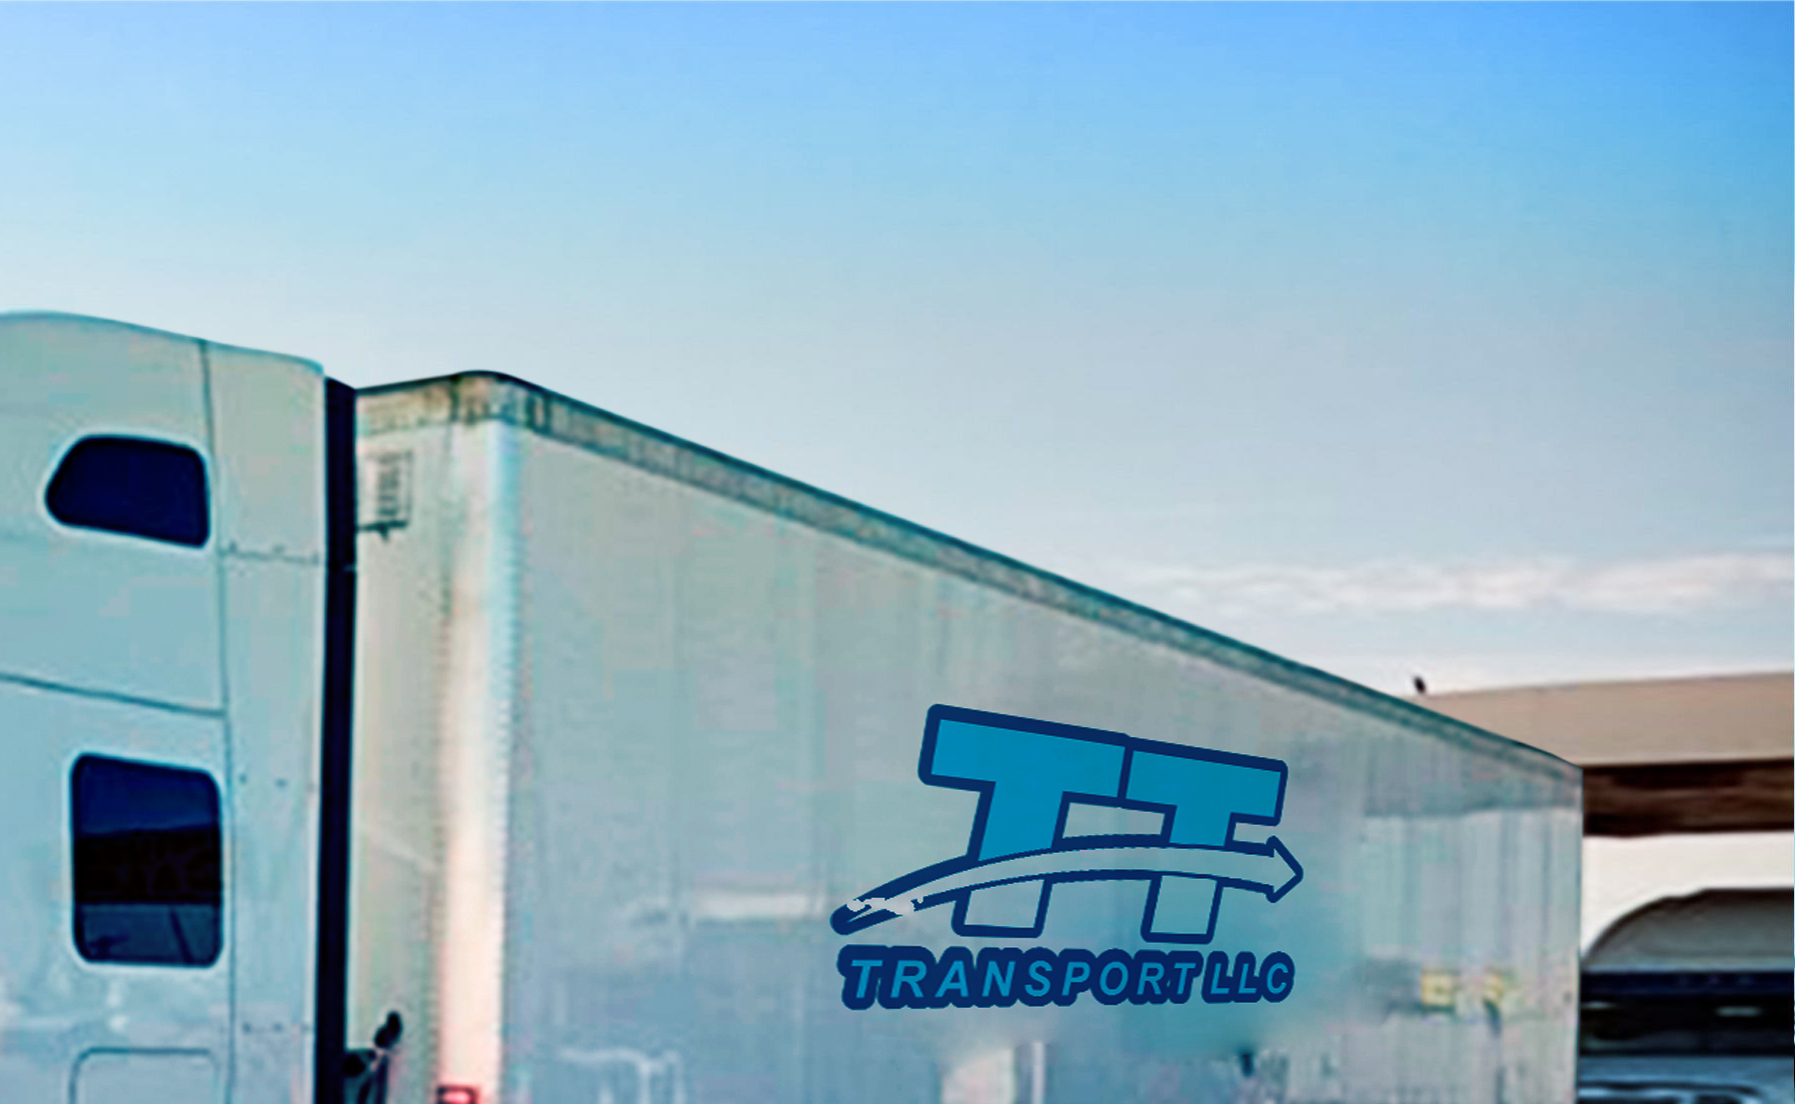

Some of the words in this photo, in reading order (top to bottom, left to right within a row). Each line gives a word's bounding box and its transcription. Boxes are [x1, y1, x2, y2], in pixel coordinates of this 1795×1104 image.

[918, 704, 1288, 944] TT
[839, 947, 1202, 1008] TRANSPORT
[1203, 953, 1294, 1001] LLC
